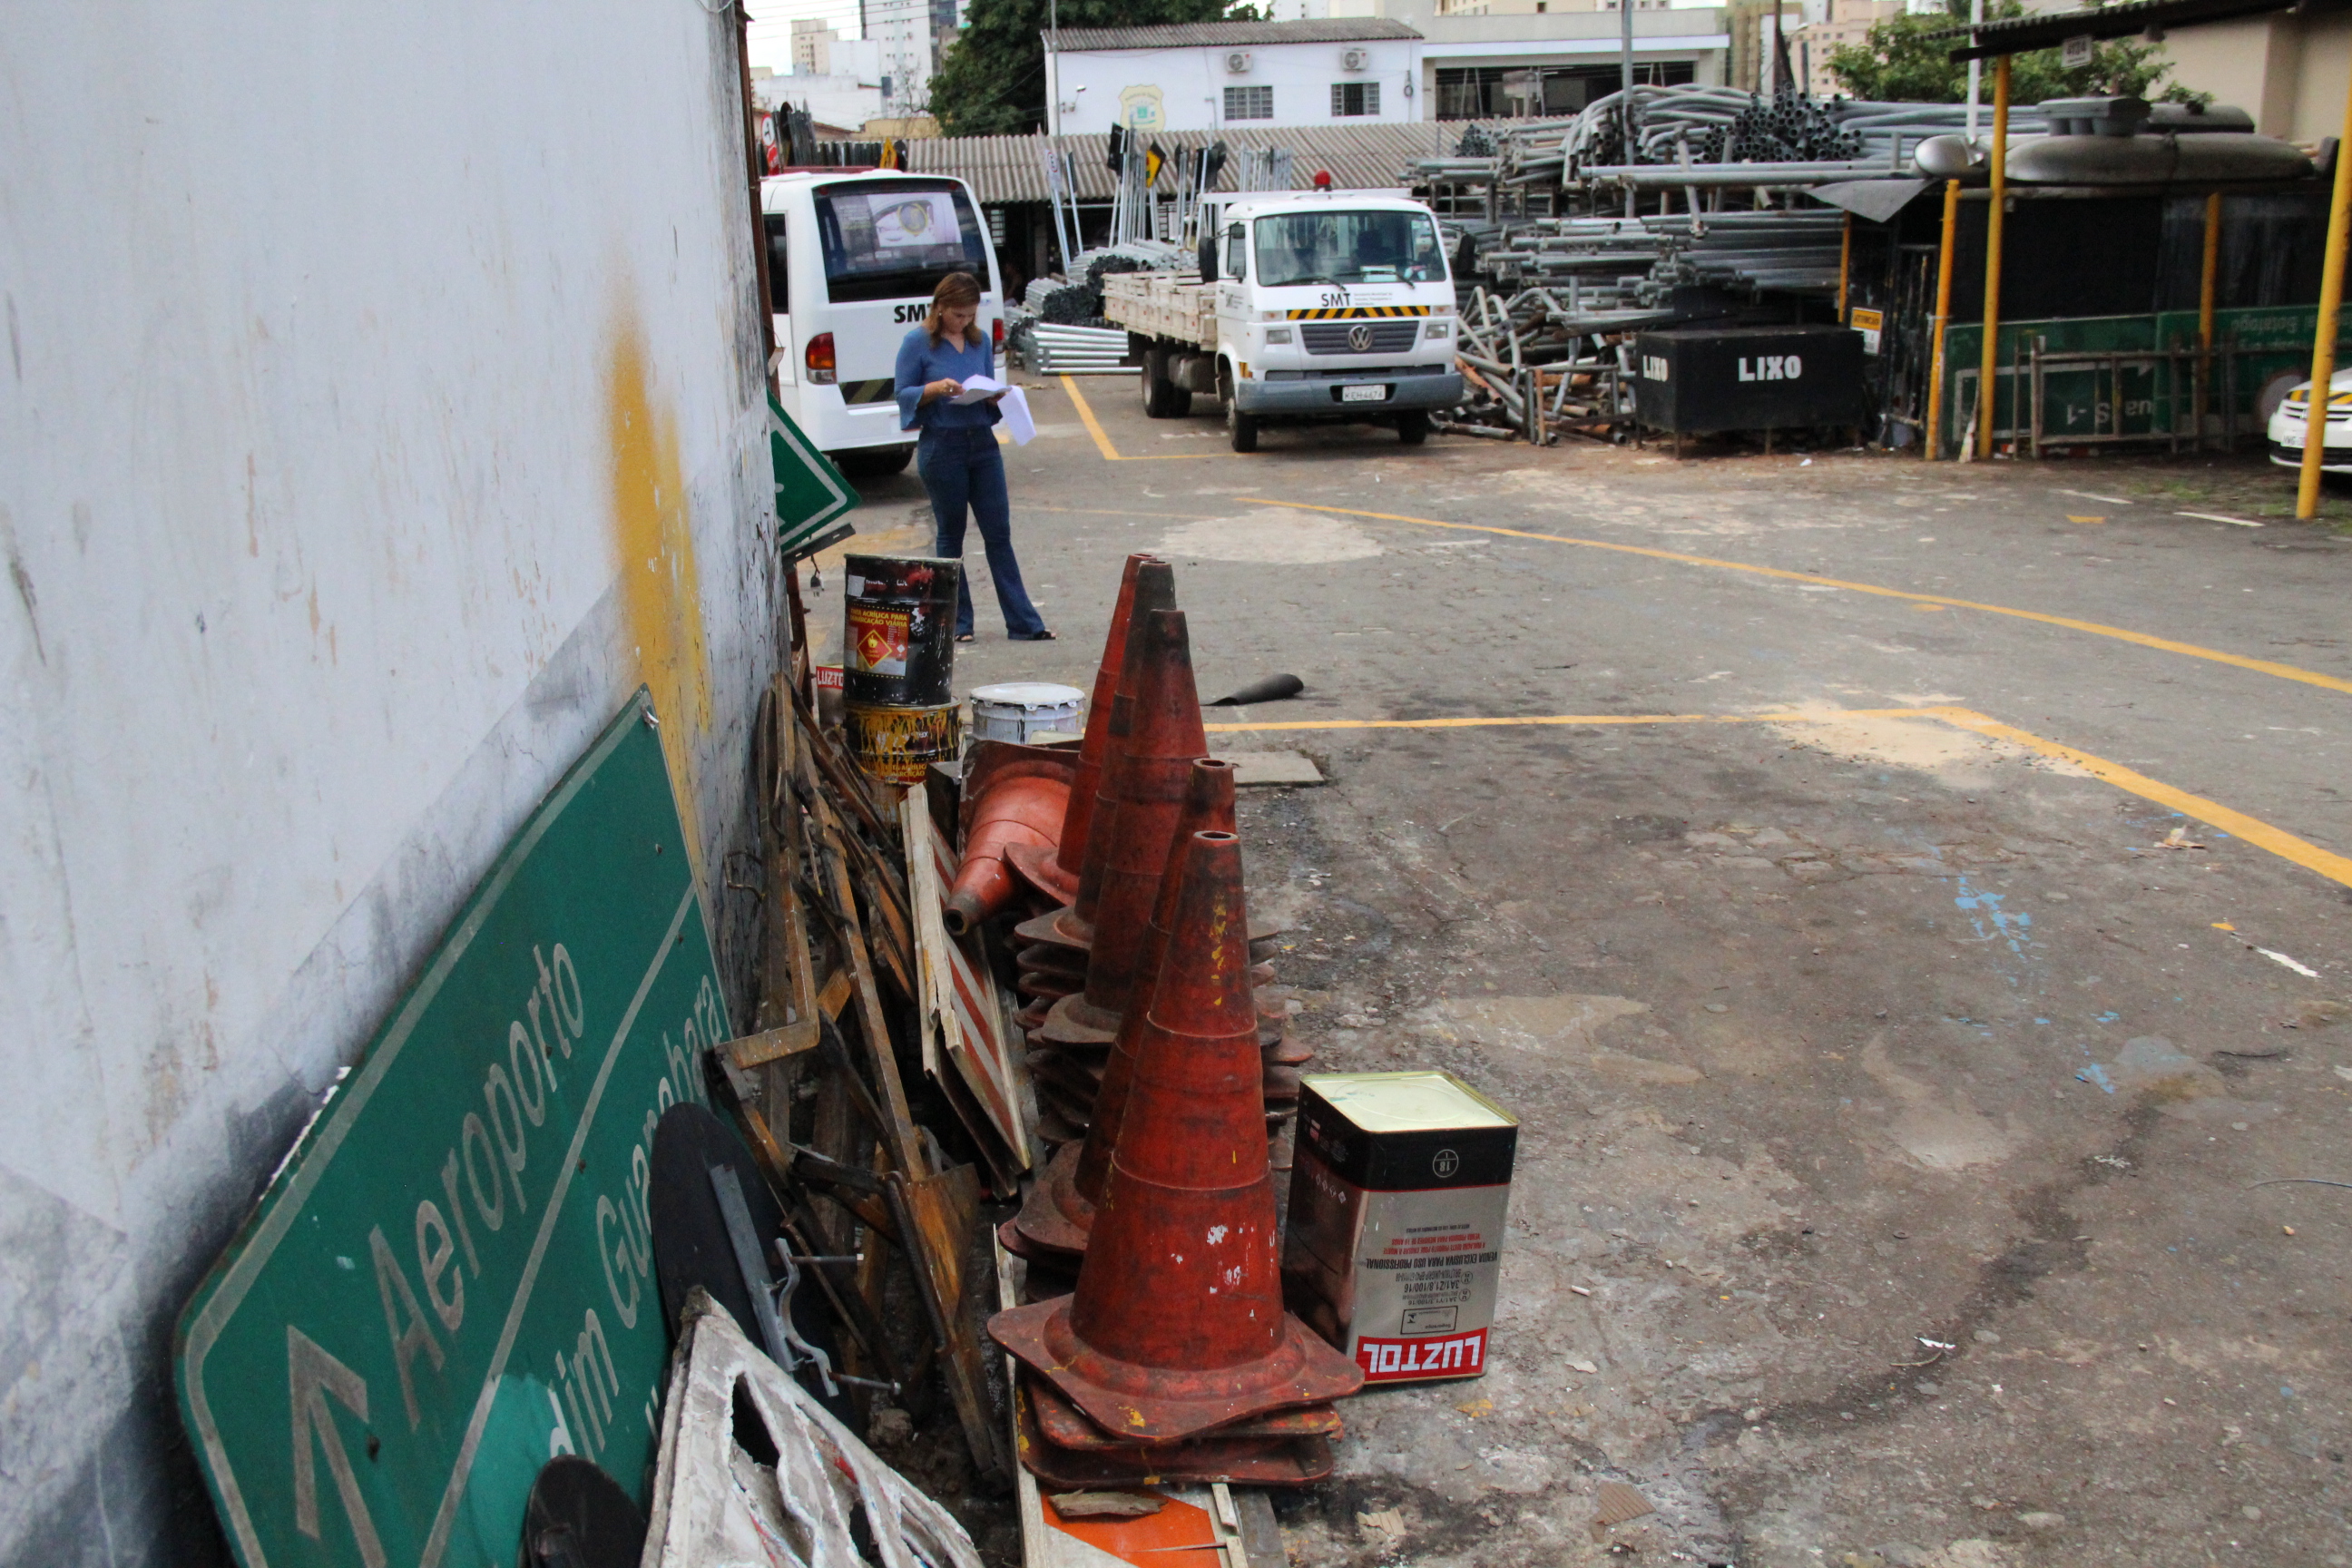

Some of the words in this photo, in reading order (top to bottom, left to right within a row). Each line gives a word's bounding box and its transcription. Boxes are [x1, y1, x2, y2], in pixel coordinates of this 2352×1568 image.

[1321, 293, 1350, 307] SMT
[1642, 355, 1668, 382] LIXO
[1739, 355, 1802, 382] LIXO
[2125, 399, 2152, 416] ua
[891, 612, 907, 621] PARA
[818, 670, 844, 687] LUZTO
[1440, 1161, 1450, 1171] 18
[369, 943, 583, 1432] Aeroporto
[1366, 1258, 1412, 1269] PROFISSIONAL
[1414, 1258, 1426, 1268] USO
[1428, 1255, 1445, 1268] PARA
[1446, 1254, 1476, 1266] EXCLUSIVA
[1479, 1251, 1497, 1263] VENDA
[1363, 1336, 1481, 1374] LUZTOL
